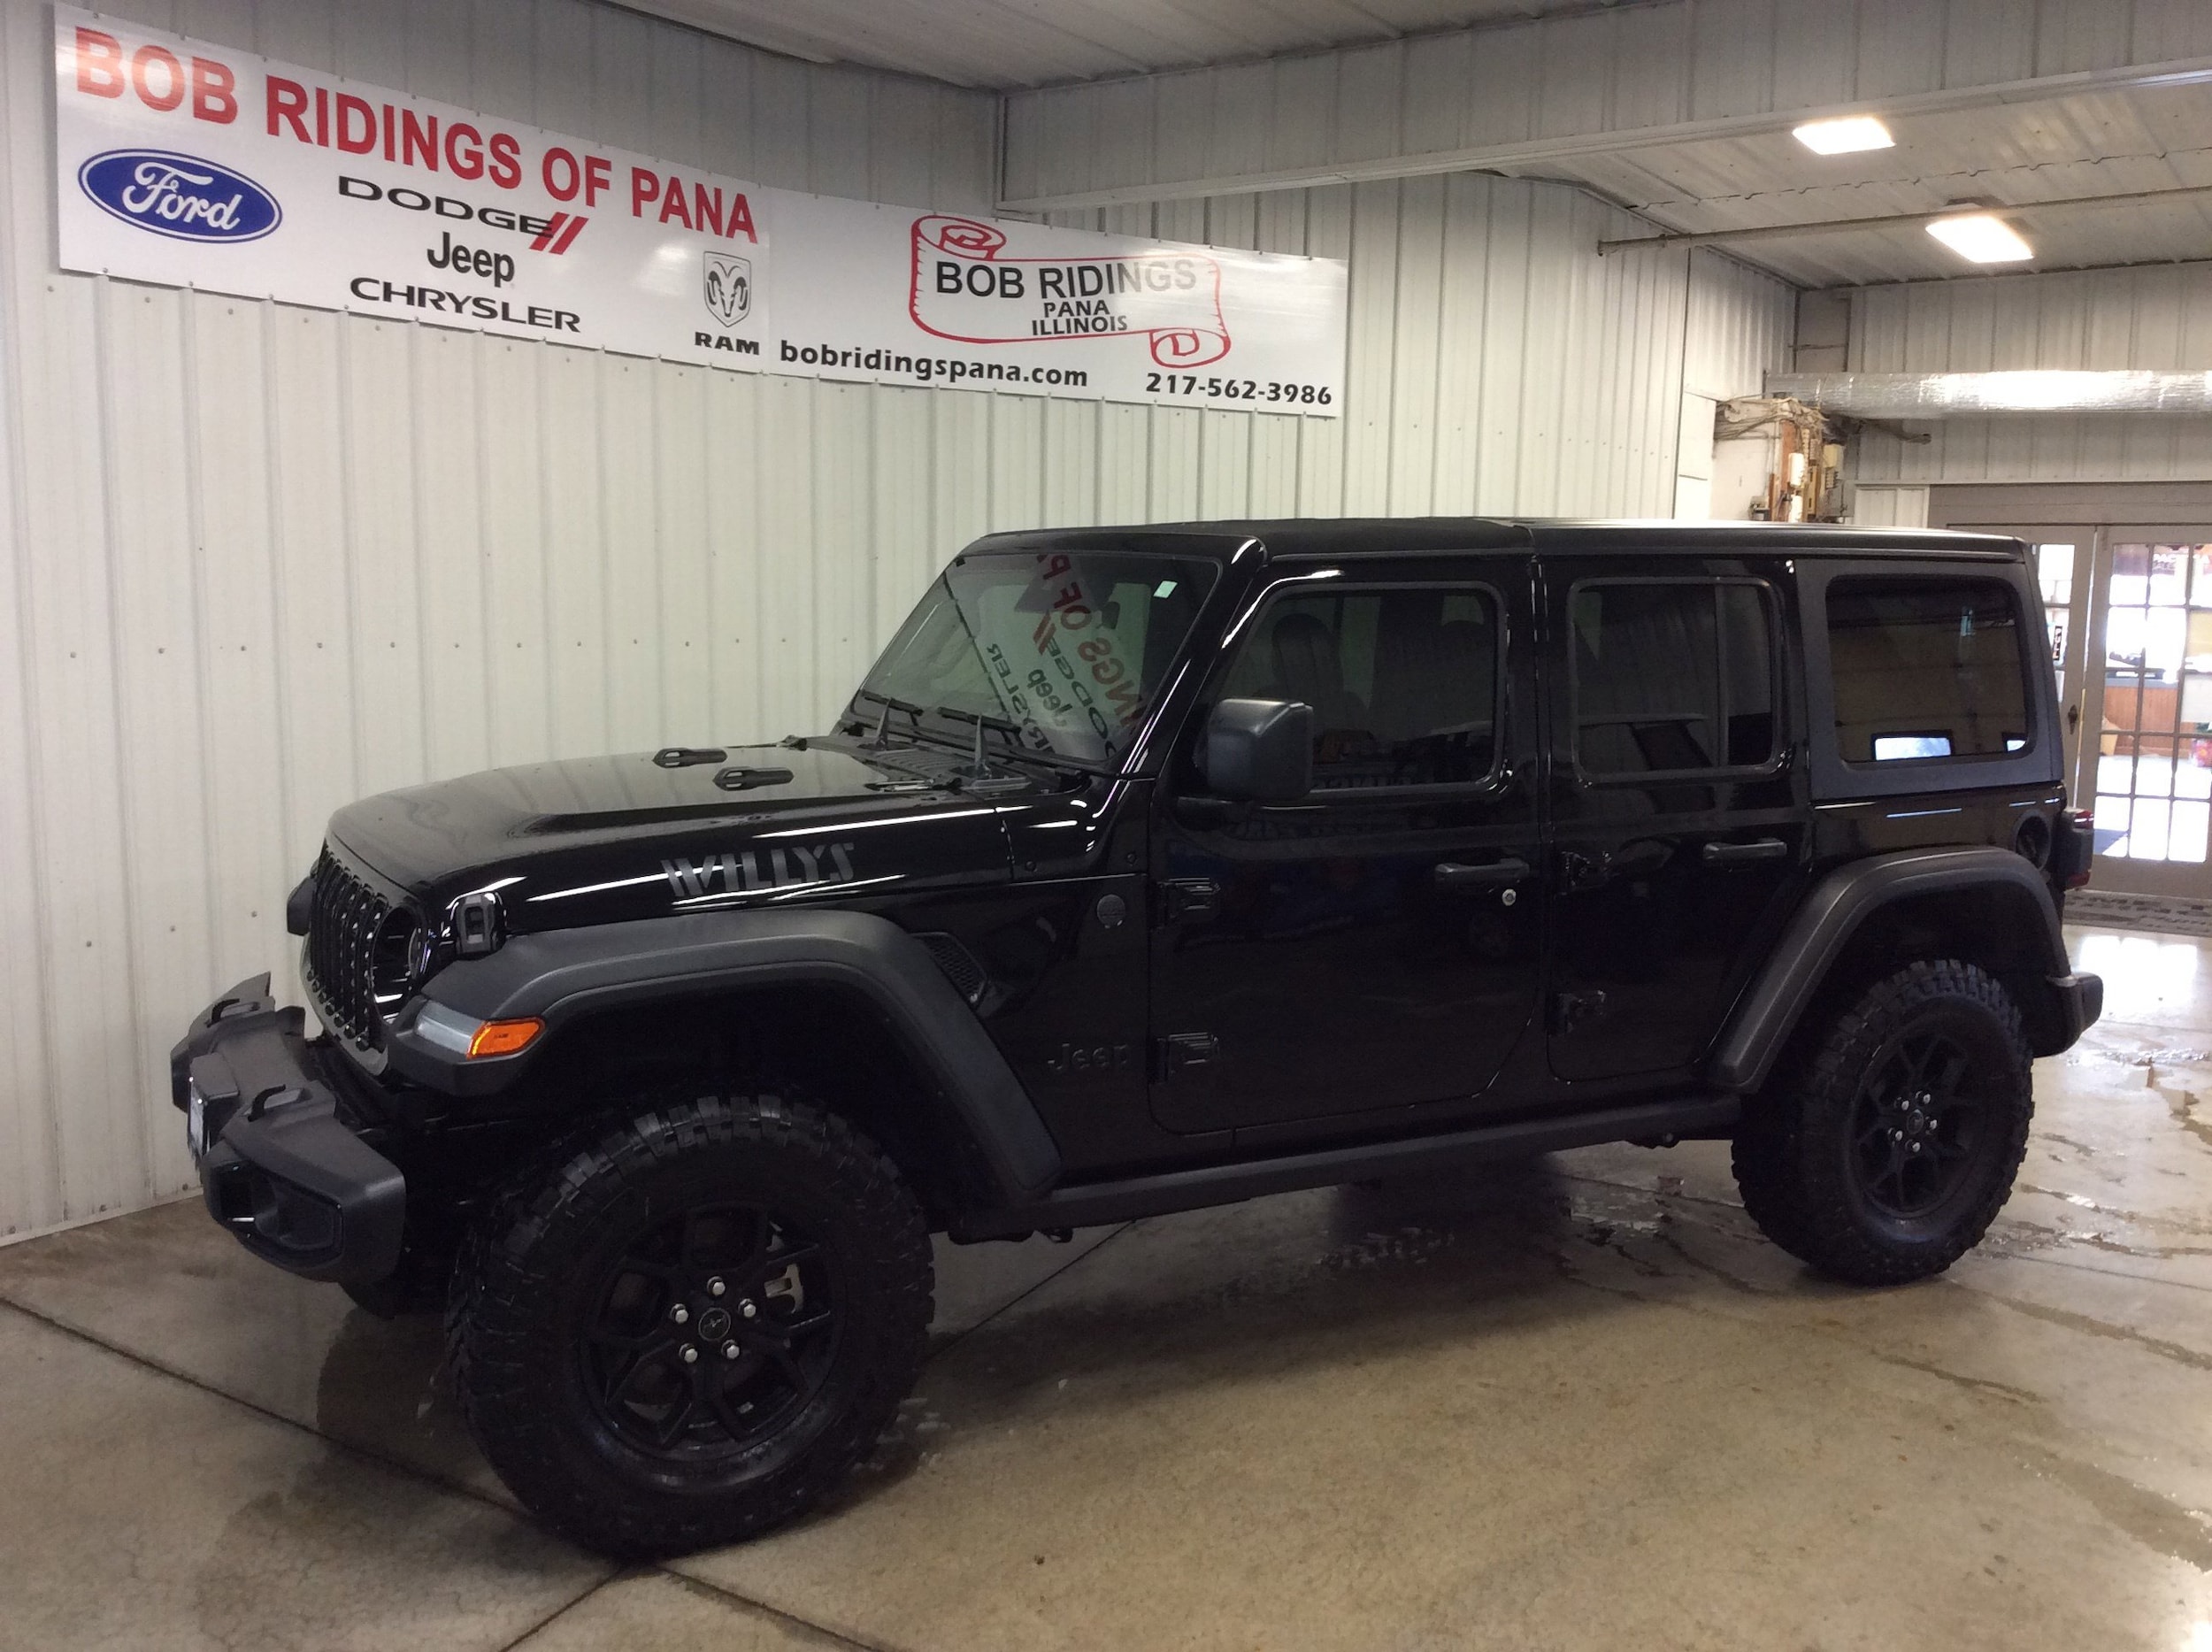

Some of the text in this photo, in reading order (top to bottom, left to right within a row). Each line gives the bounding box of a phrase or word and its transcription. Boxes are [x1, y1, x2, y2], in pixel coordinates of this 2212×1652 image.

[74, 26, 758, 244] BOB RIDINGS OF PANA
[122, 161, 243, 230] Ford
[339, 175, 556, 239] DODGE
[426, 231, 516, 288] Jeep
[935, 258, 1196, 299] BOB RIDINGS
[349, 277, 581, 334] CHRYSLER
[1032, 315, 1128, 336] ILLINOIS
[1043, 299, 1111, 319] PANA
[694, 330, 760, 356] RAM
[780, 339, 1088, 387] bobridingspana.com
[1145, 373, 1333, 405] 217-562-3986
[2052, 627, 2062, 659] PULL
[660, 842, 855, 897] WILLYS
[1047, 1041, 1129, 1072] Jeep
